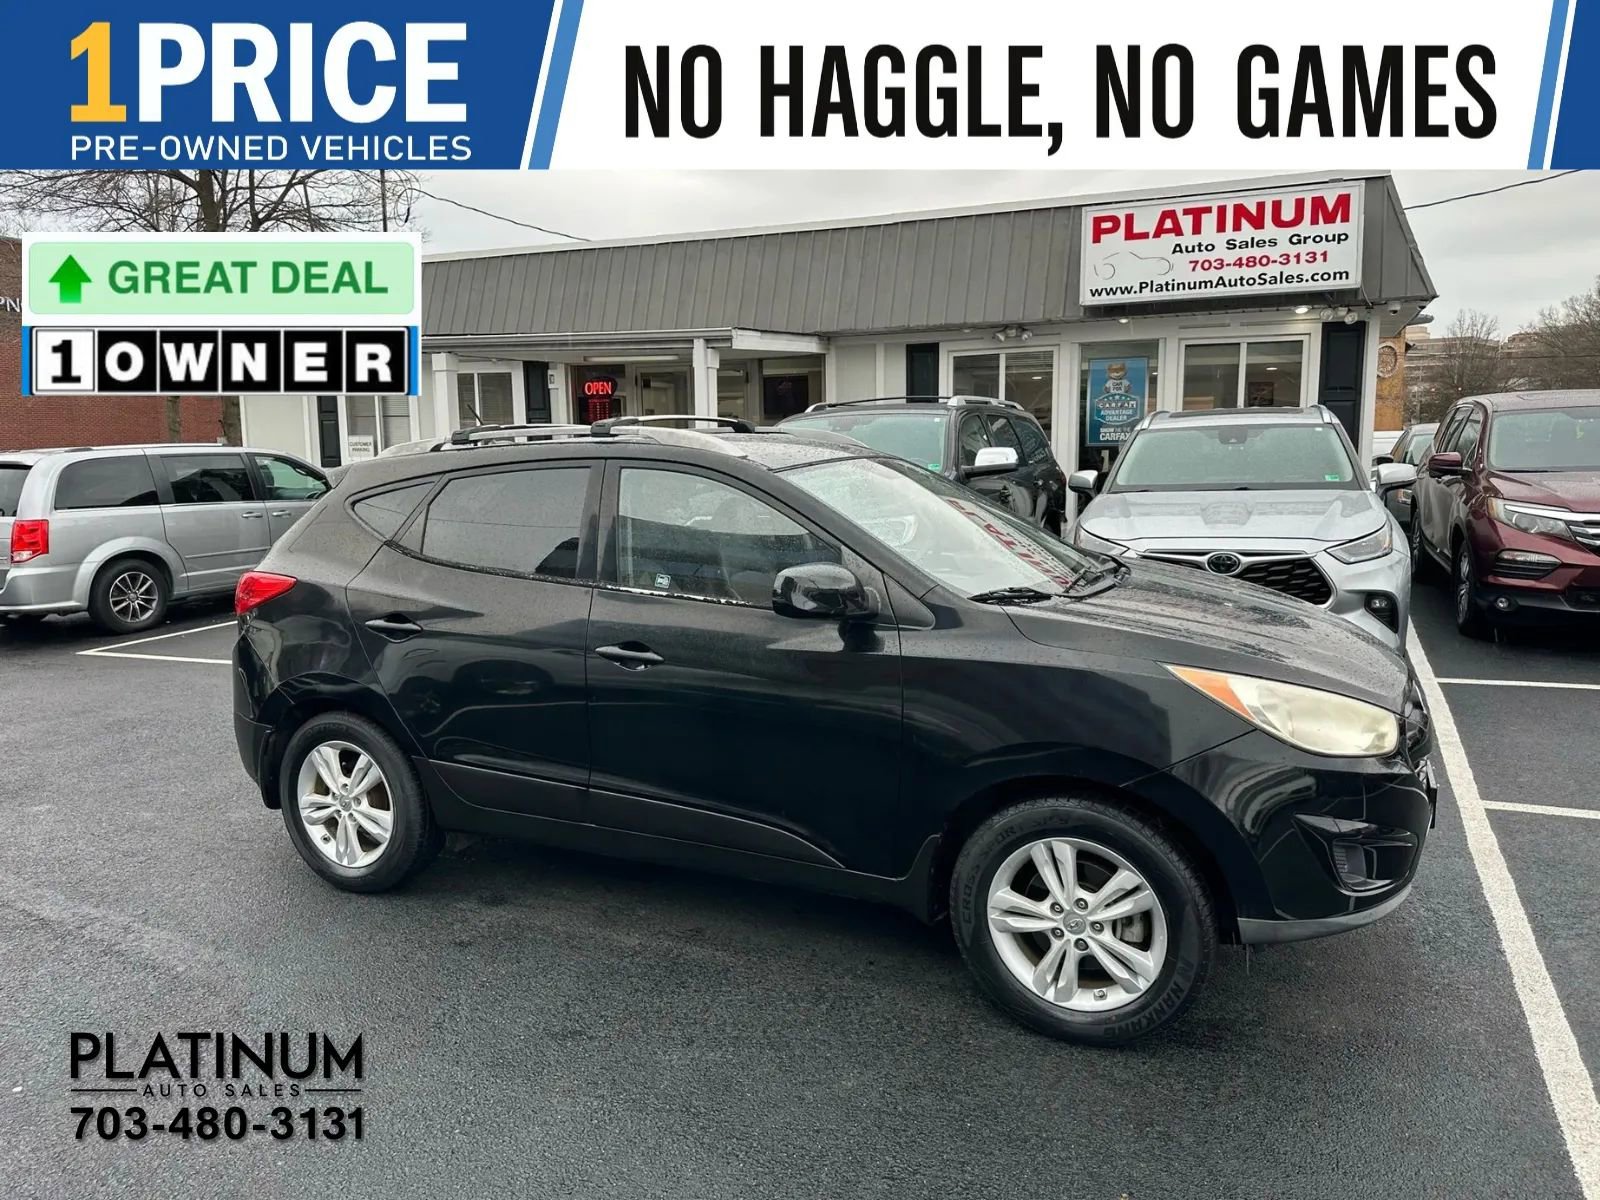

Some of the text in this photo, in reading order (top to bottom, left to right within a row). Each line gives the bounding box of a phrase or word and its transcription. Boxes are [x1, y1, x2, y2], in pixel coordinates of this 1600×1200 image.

[1091, 192, 1352, 244] PLATINUM
[1171, 231, 1349, 255] Auto Sales Group
[1188, 250, 1329, 272] 703-480-3131
[1089, 268, 1350, 298] www.PlatinumAutoSales.com
[584, 381, 612, 395] OPEN
[1100, 432, 1131, 441] CARFAX
